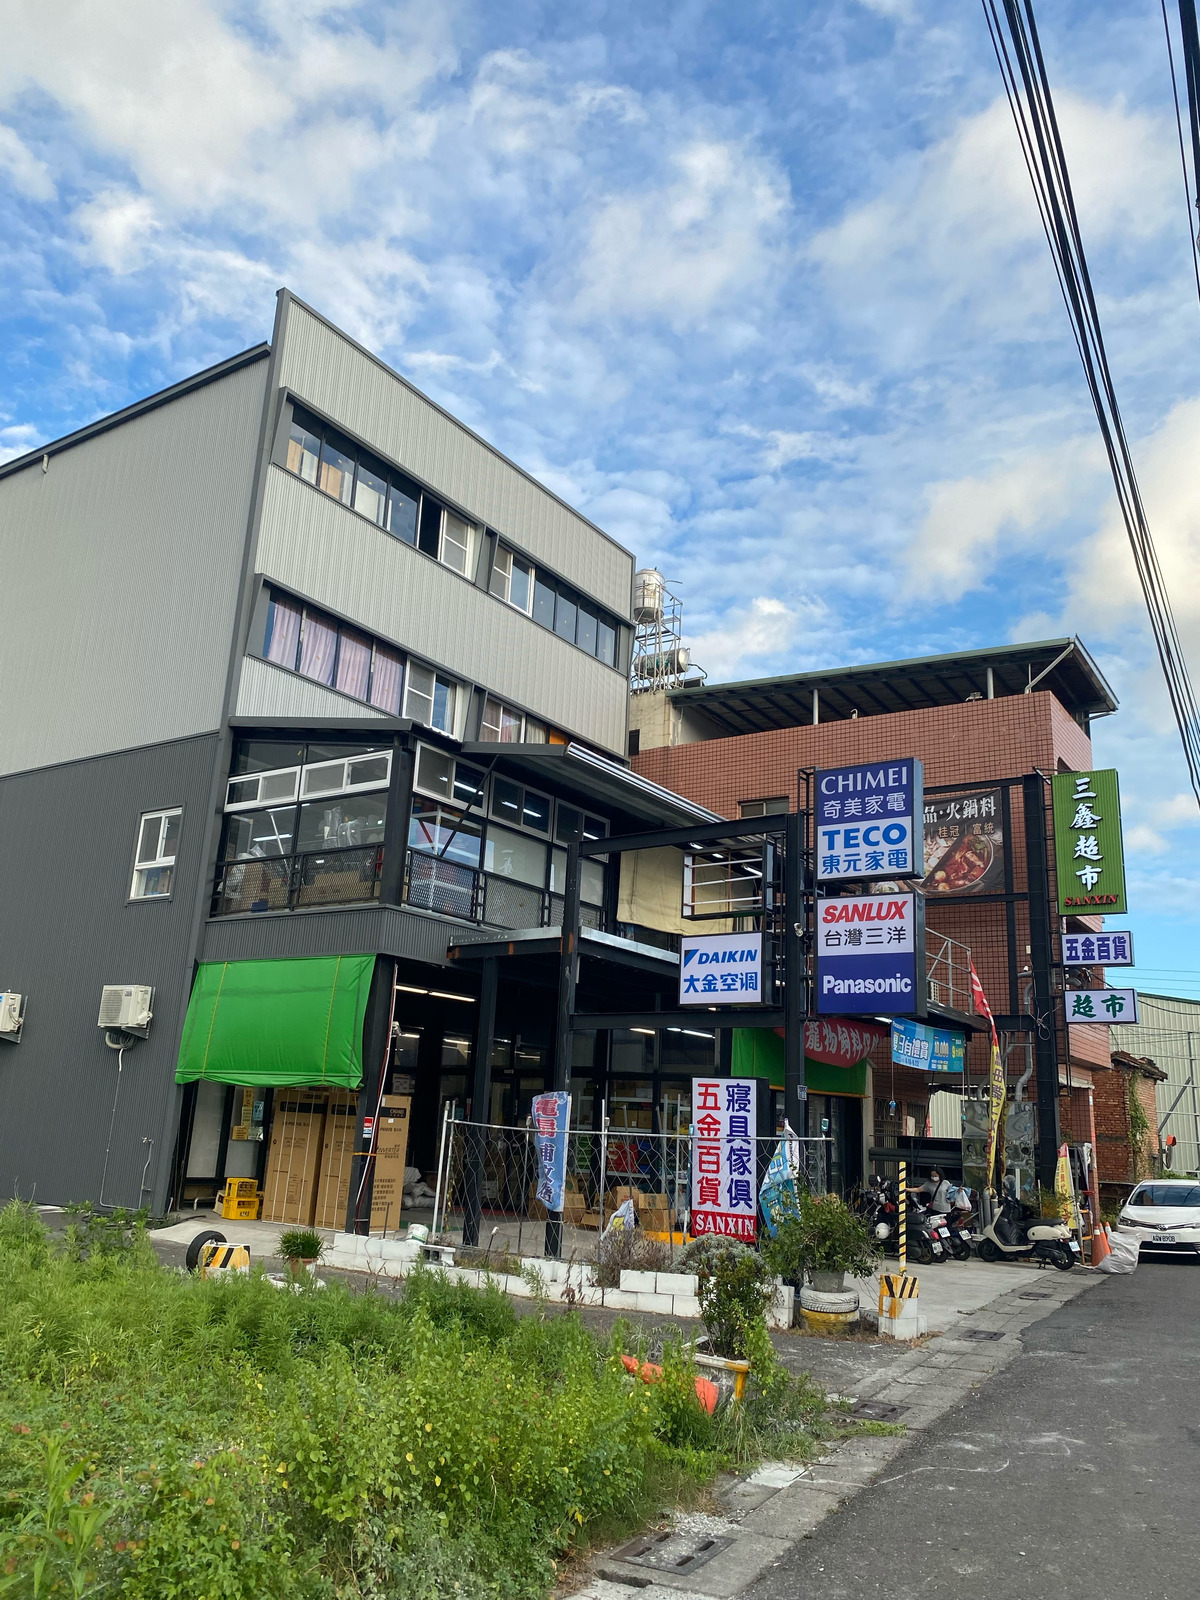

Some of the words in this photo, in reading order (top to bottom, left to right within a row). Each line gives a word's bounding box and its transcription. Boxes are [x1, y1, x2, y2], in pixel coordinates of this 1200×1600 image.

[821, 766, 908, 795] CHIMEI
[823, 791, 906, 819] 奇美家電
[822, 822, 908, 850] TECO
[938, 825, 960, 838] 桂冠
[1069, 777, 1103, 892] 三鑫超市
[821, 848, 908, 875] 東元家電
[822, 900, 909, 924] SANLUX
[1064, 894, 1120, 907] SANXIN
[823, 926, 907, 948] 台灣三洋
[1065, 935, 1129, 962] 五金百貨
[697, 949, 758, 965] DAIKIN
[683, 971, 758, 994] 大金空调
[822, 973, 912, 995] Panasonic
[1071, 994, 1127, 1019] 超市
[696, 1083, 722, 1208] 五金百貨
[695, 1214, 755, 1236] SANXIN
